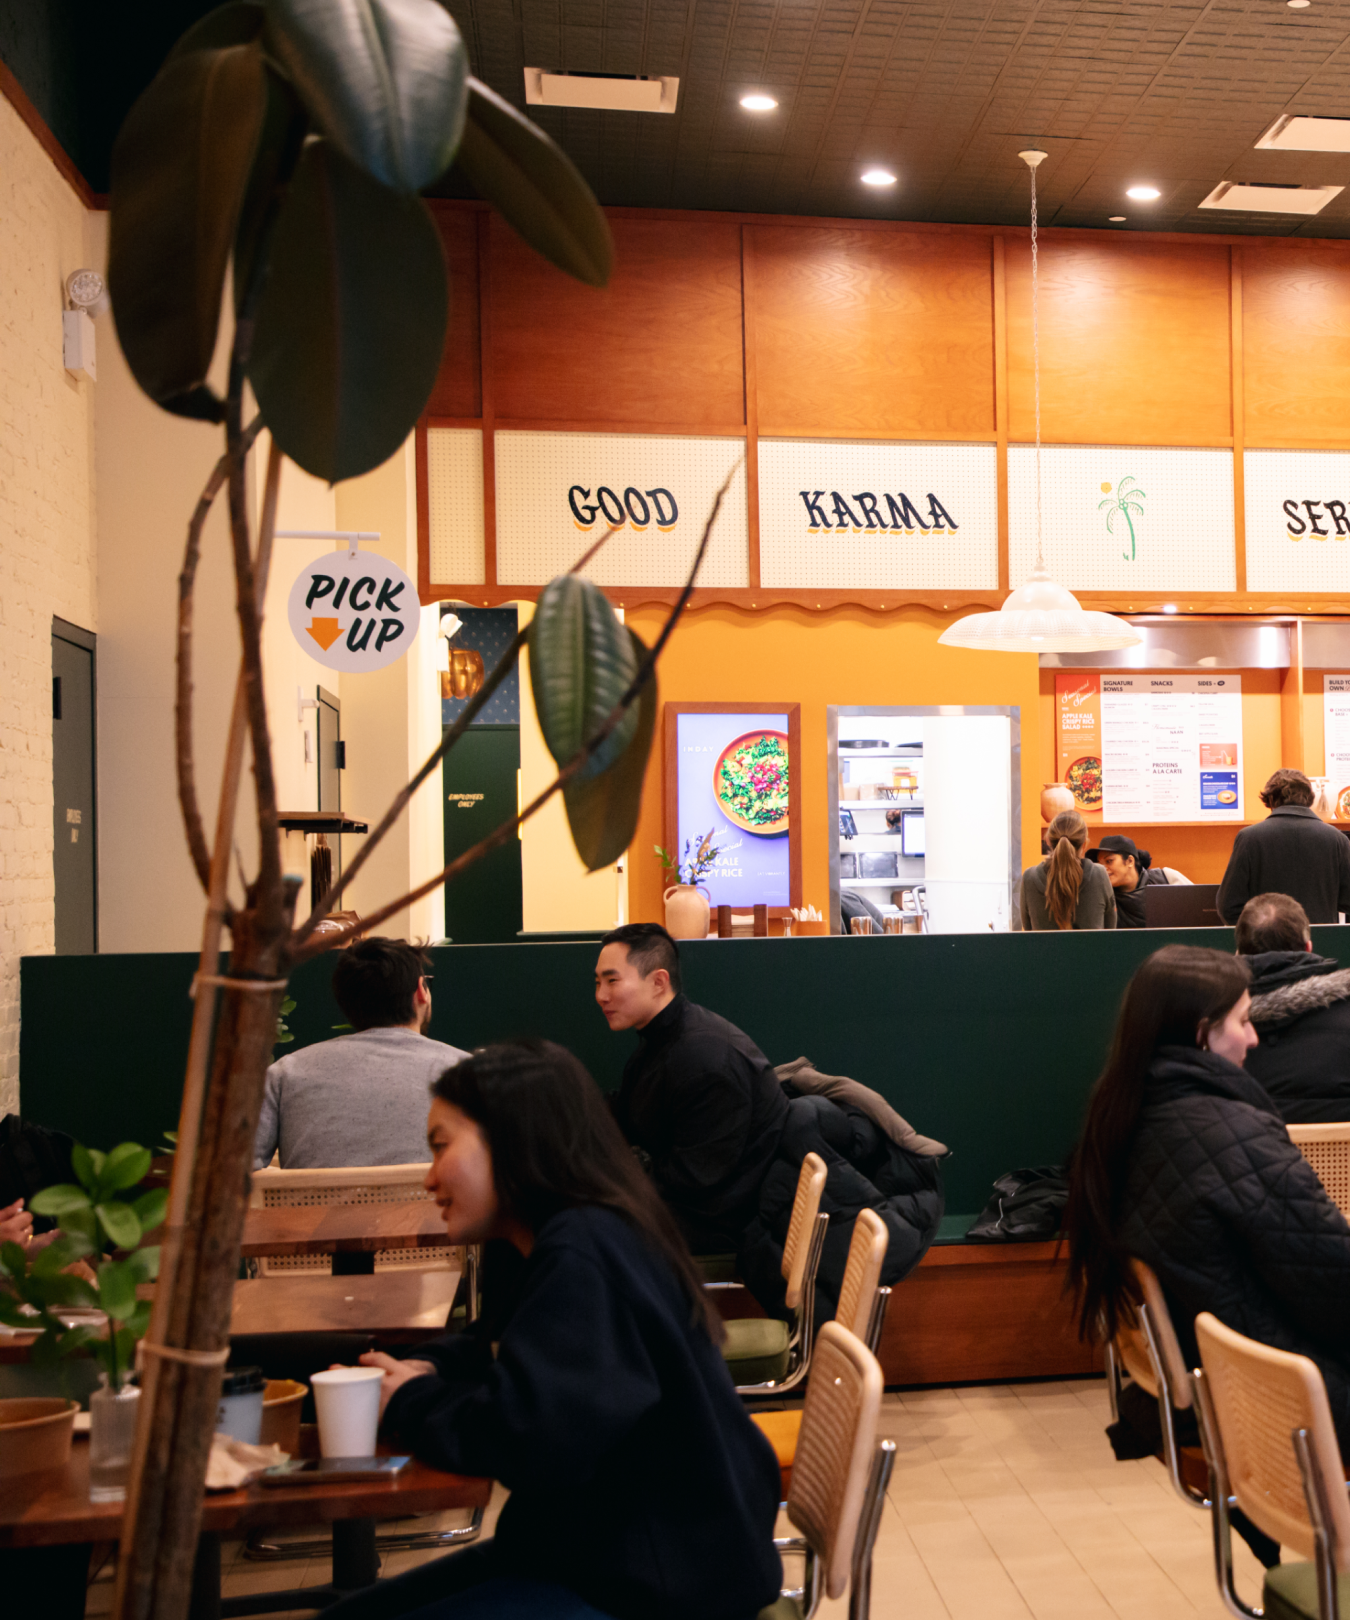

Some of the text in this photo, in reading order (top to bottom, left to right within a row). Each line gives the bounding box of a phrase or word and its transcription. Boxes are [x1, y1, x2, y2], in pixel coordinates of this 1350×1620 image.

[568, 485, 679, 529] GOOD
[799, 490, 960, 532] KARMA
[305, 574, 405, 612] PICK
[346, 617, 404, 652] UP
[1073, 685, 1097, 707] Special
[448, 793, 485, 801] EMPLOYEES
[457, 800, 476, 808] ONLY
[715, 857, 739, 866] KALE
[721, 869, 743, 878] RICE
